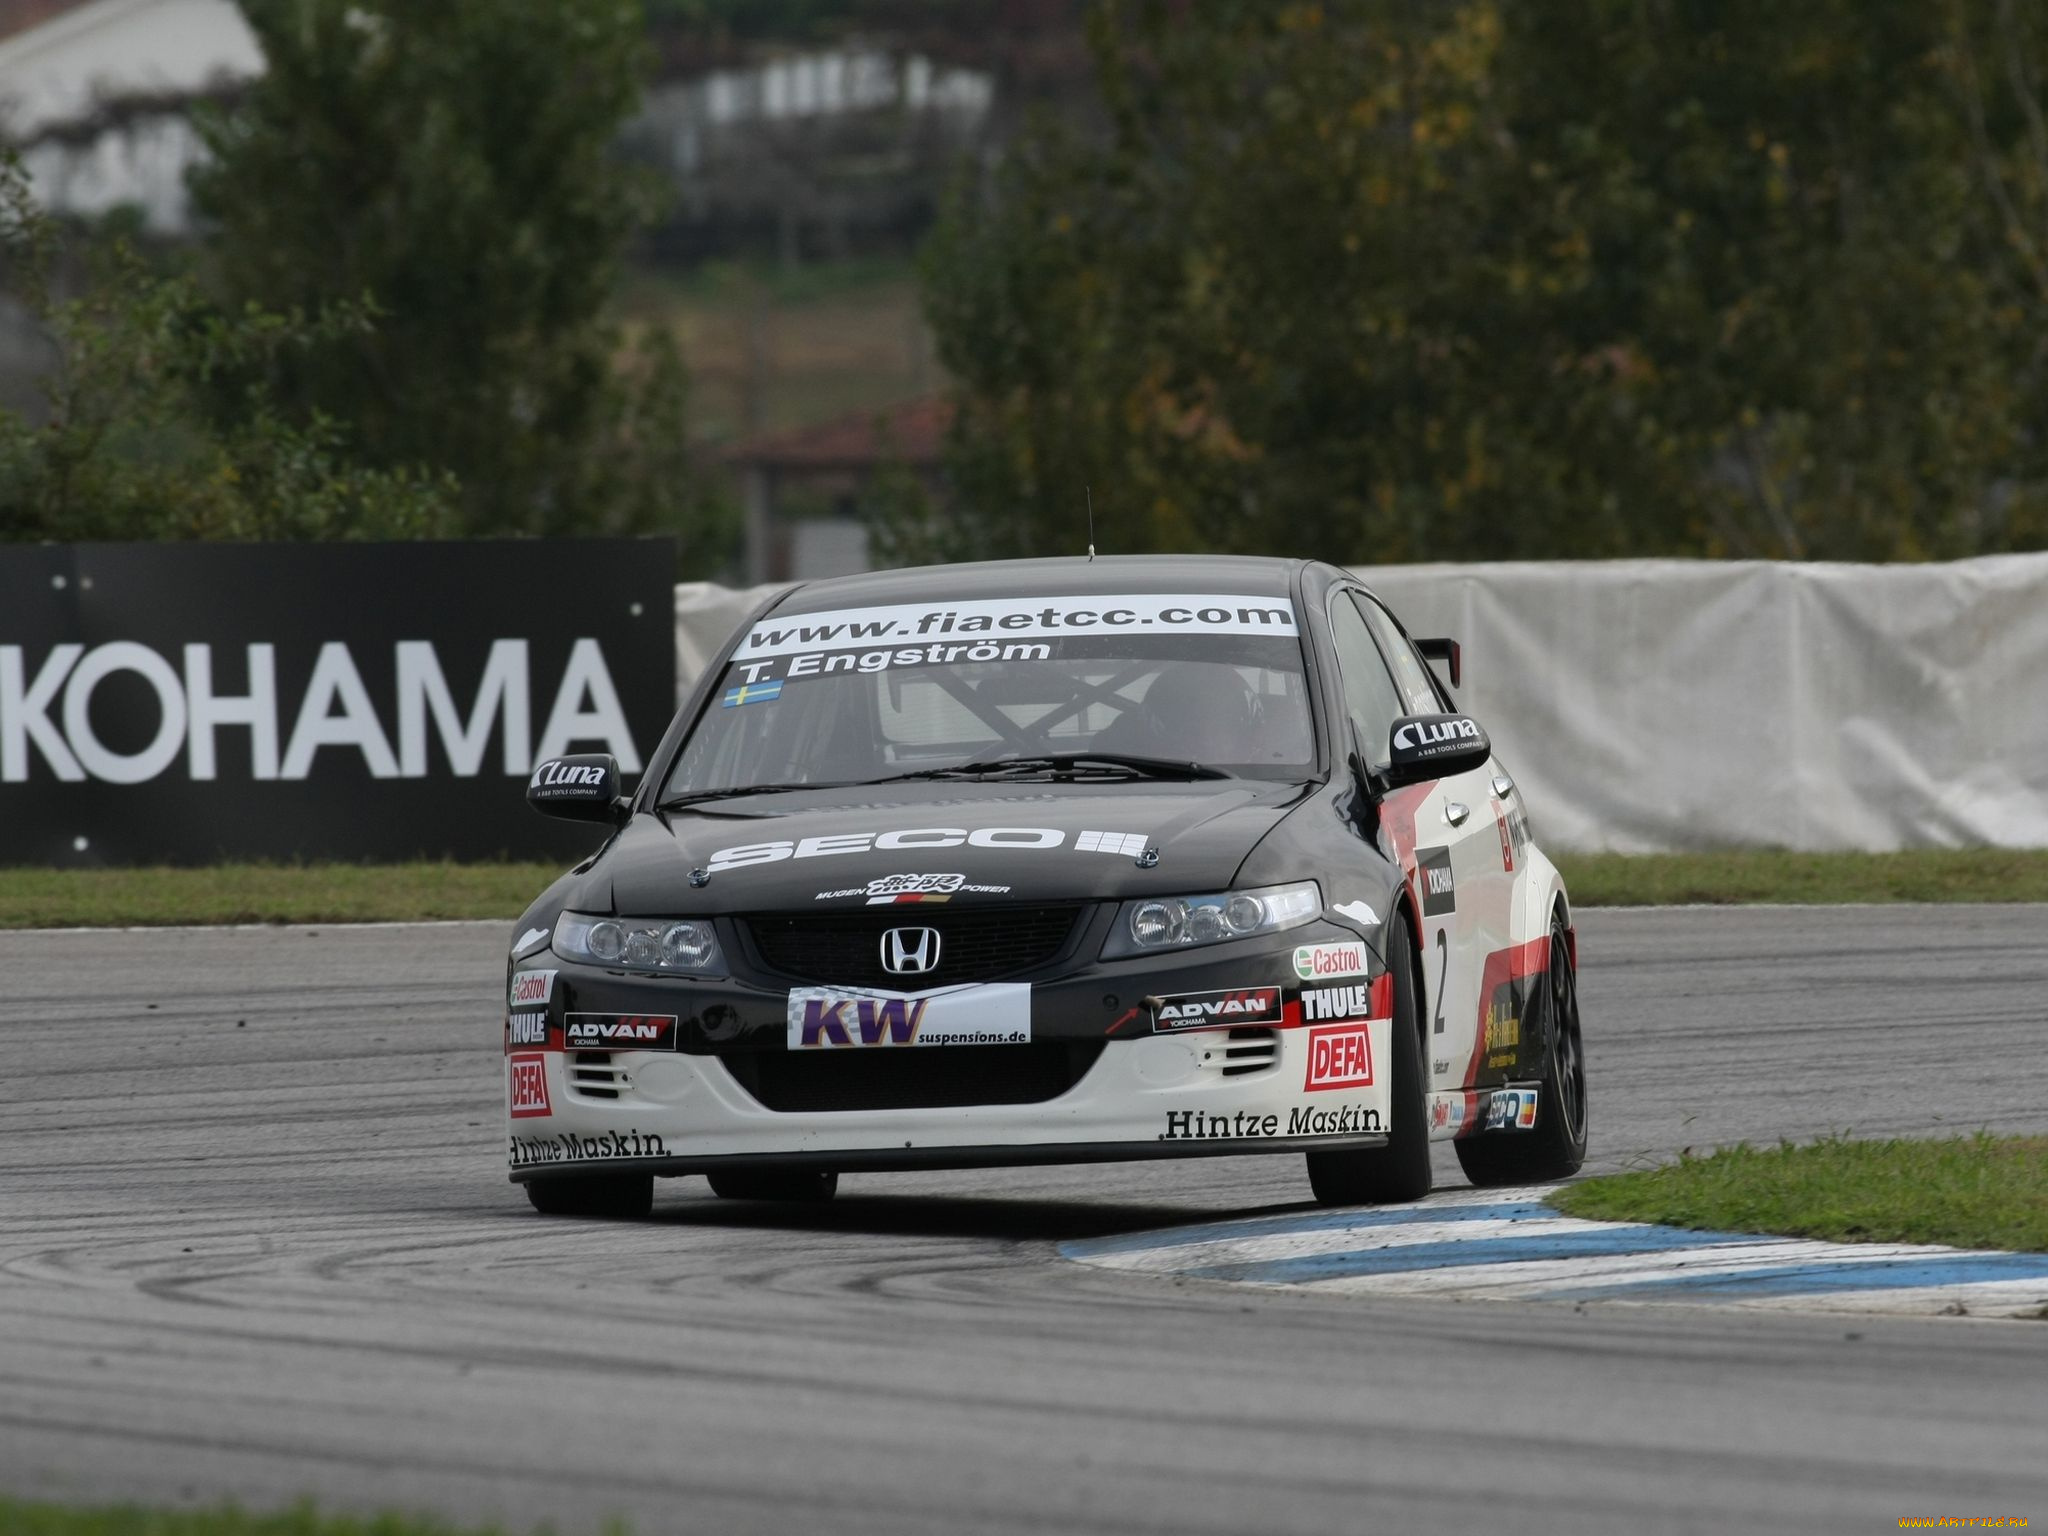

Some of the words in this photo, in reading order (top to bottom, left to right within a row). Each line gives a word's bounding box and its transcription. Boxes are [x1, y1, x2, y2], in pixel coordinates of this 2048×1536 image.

[749, 606, 1293, 649] www.fiaetcc.com
[739, 661, 770, 684] T.
[787, 641, 1051, 677] Engström
[0, 638, 641, 785] KOHAMA
[1414, 719, 1480, 745] Luna
[1437, 744, 1456, 753] TOOLS
[544, 761, 606, 786] Luna
[707, 828, 1065, 872] SECO
[815, 887, 867, 900] MUGEN
[959, 884, 1011, 893] POWER
[1313, 948, 1361, 974] Castrol
[516, 974, 548, 1000] Castrol
[1158, 998, 1267, 1020] ADVAN
[1301, 984, 1367, 1020] THULE
[509, 1012, 545, 1044] THULE
[567, 1023, 657, 1039] ADVAN
[801, 998, 928, 1047] KW
[918, 1031, 1026, 1046] suspensions.de
[1169, 1016, 1206, 1028] YOKOHAMA
[1314, 1035, 1367, 1080] DEFA
[512, 1065, 545, 1106] DEFA
[1165, 1111, 1278, 1138] Hintze
